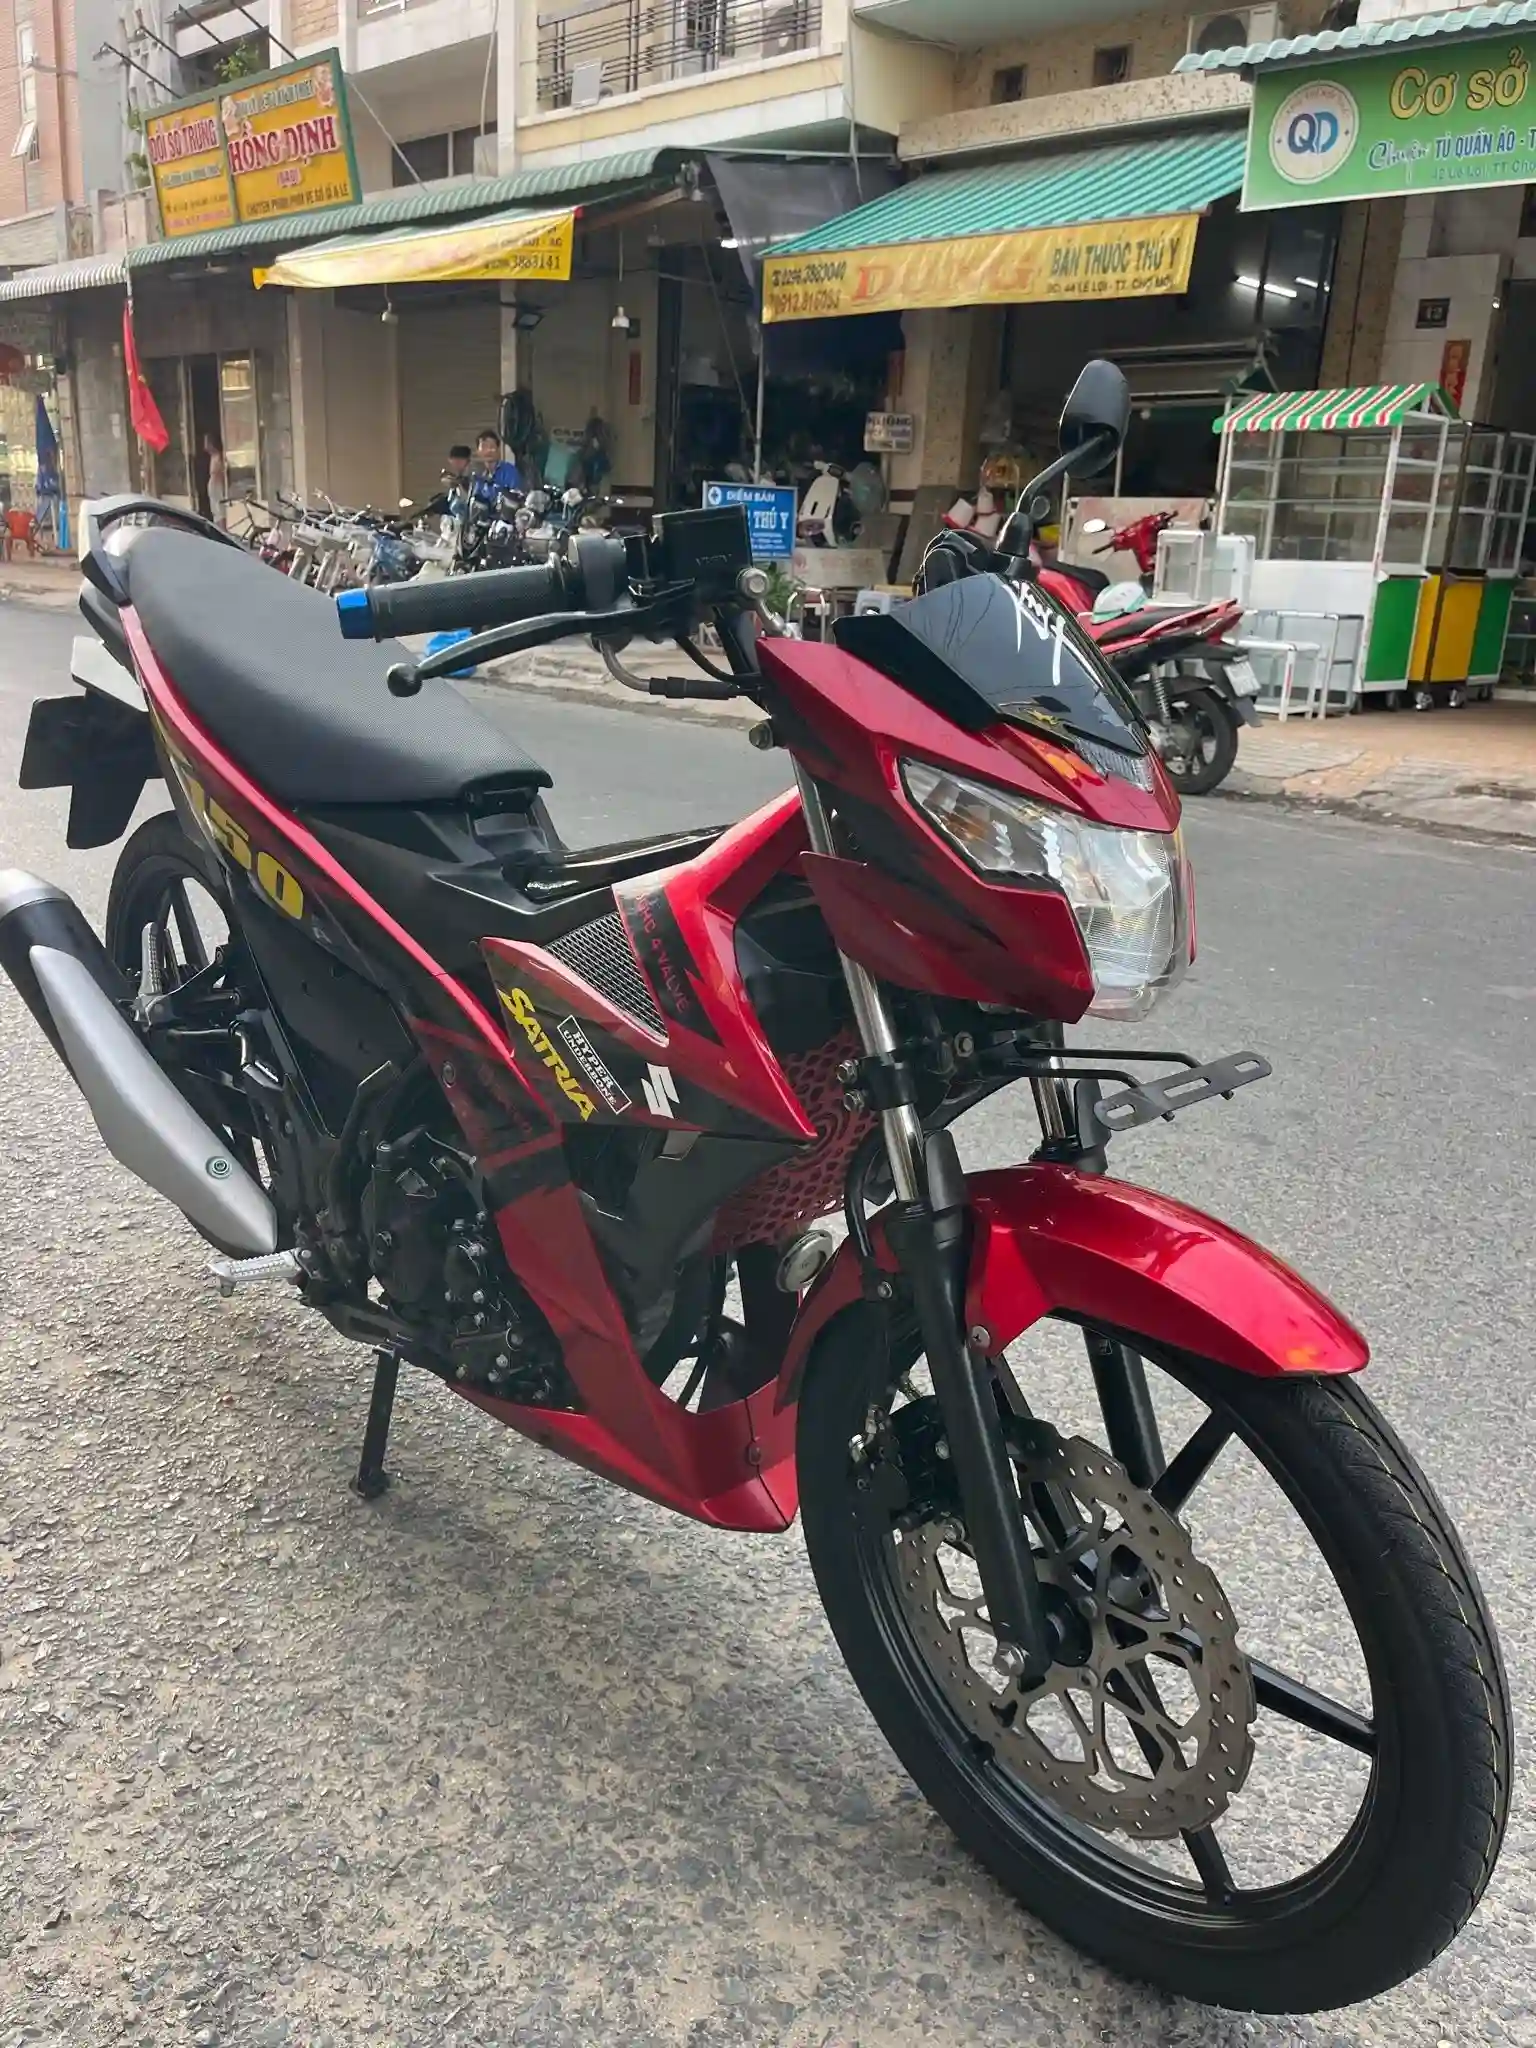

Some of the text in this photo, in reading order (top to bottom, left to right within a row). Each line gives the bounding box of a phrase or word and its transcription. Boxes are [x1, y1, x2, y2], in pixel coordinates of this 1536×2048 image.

[1390, 66, 1459, 120] Cơ
[1465, 45, 1530, 112] sở
[1052, 238, 1081, 278] BÁN
[1135, 229, 1166, 272] THÚ
[1168, 237, 1180, 269] Y
[753, 506, 789, 530] THÚ Y
[658, 950, 690, 1014] VALVE
[497, 987, 600, 1122] SATRIA
[562, 1028, 617, 1106] UNDERBONE
[573, 1029, 615, 1090] HYPER
